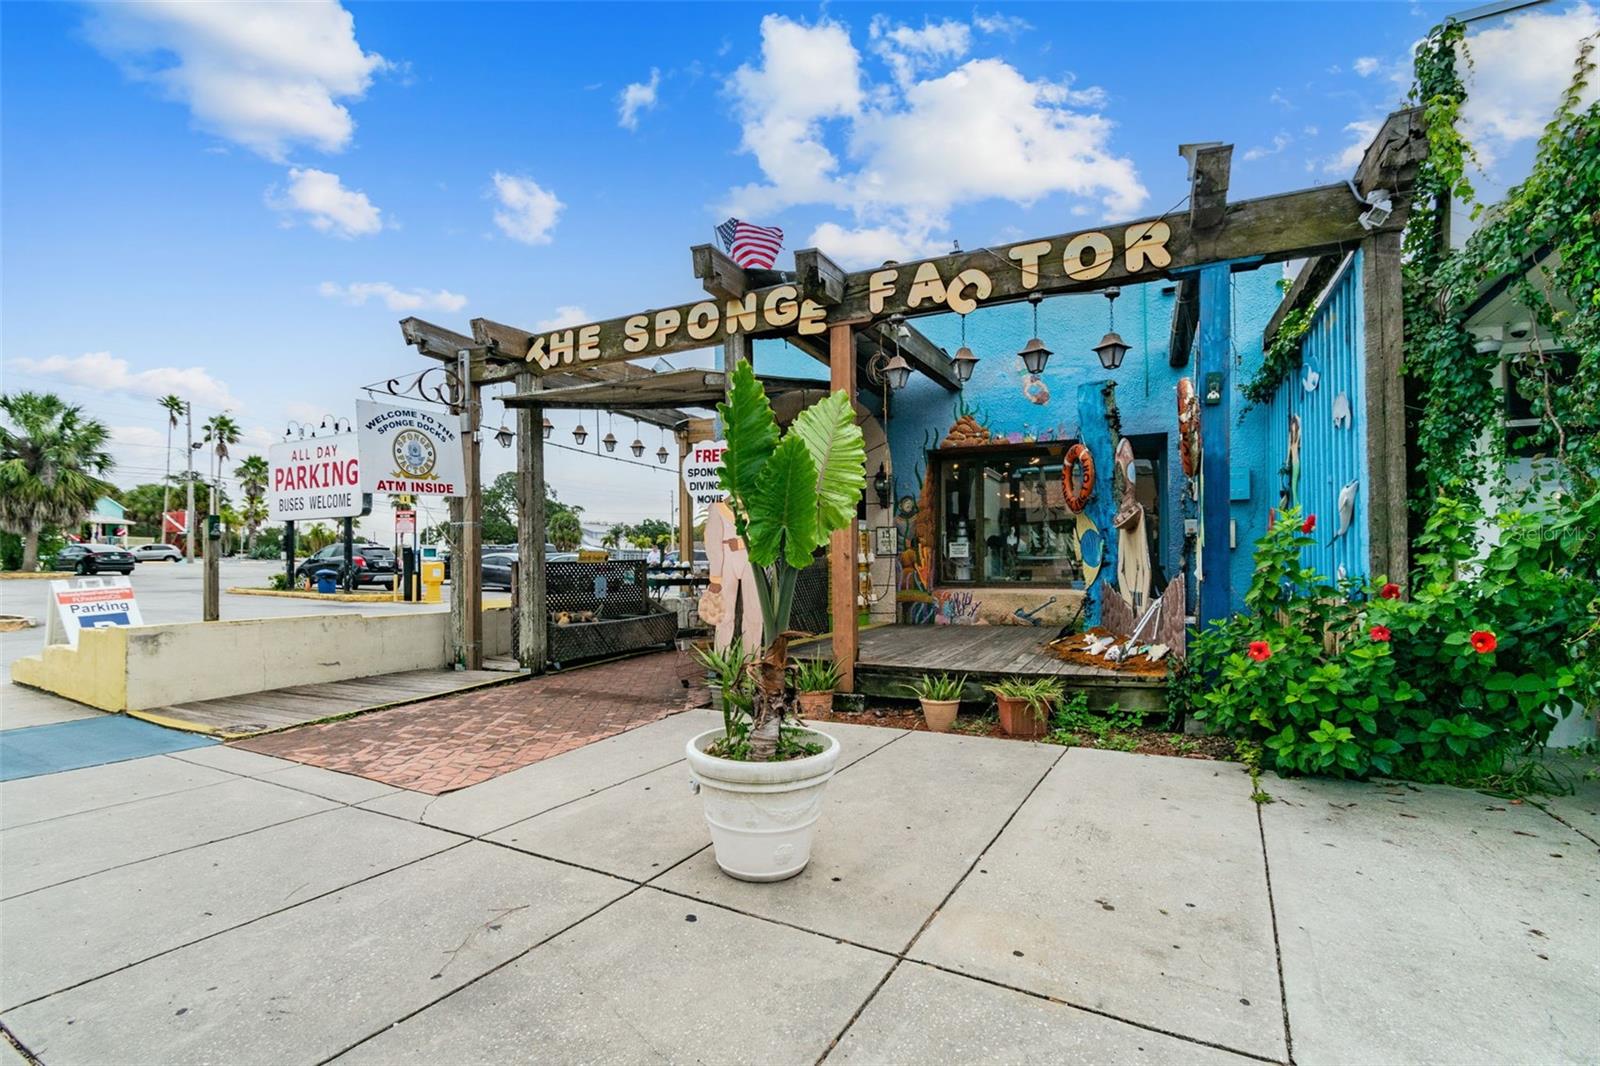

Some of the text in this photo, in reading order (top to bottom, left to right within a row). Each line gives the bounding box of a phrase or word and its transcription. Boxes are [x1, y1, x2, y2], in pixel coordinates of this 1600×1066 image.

[525, 219, 1172, 370] THE SPONGE FACTOR
[365, 410, 456, 441] WELCOME TO THE
[377, 419, 447, 443] SPONGE DOCKS
[397, 432, 431, 450] SPONGE
[291, 444, 337, 461] ALL DAY
[275, 458, 358, 492] PARKING
[687, 467, 718, 478] SPON
[376, 480, 454, 494] ATM INSIDE
[689, 481, 720, 491] DIVING
[279, 492, 352, 512] BUSES WELCOME
[697, 494, 724, 504] MOVIE
[70, 601, 130, 614] Parking
